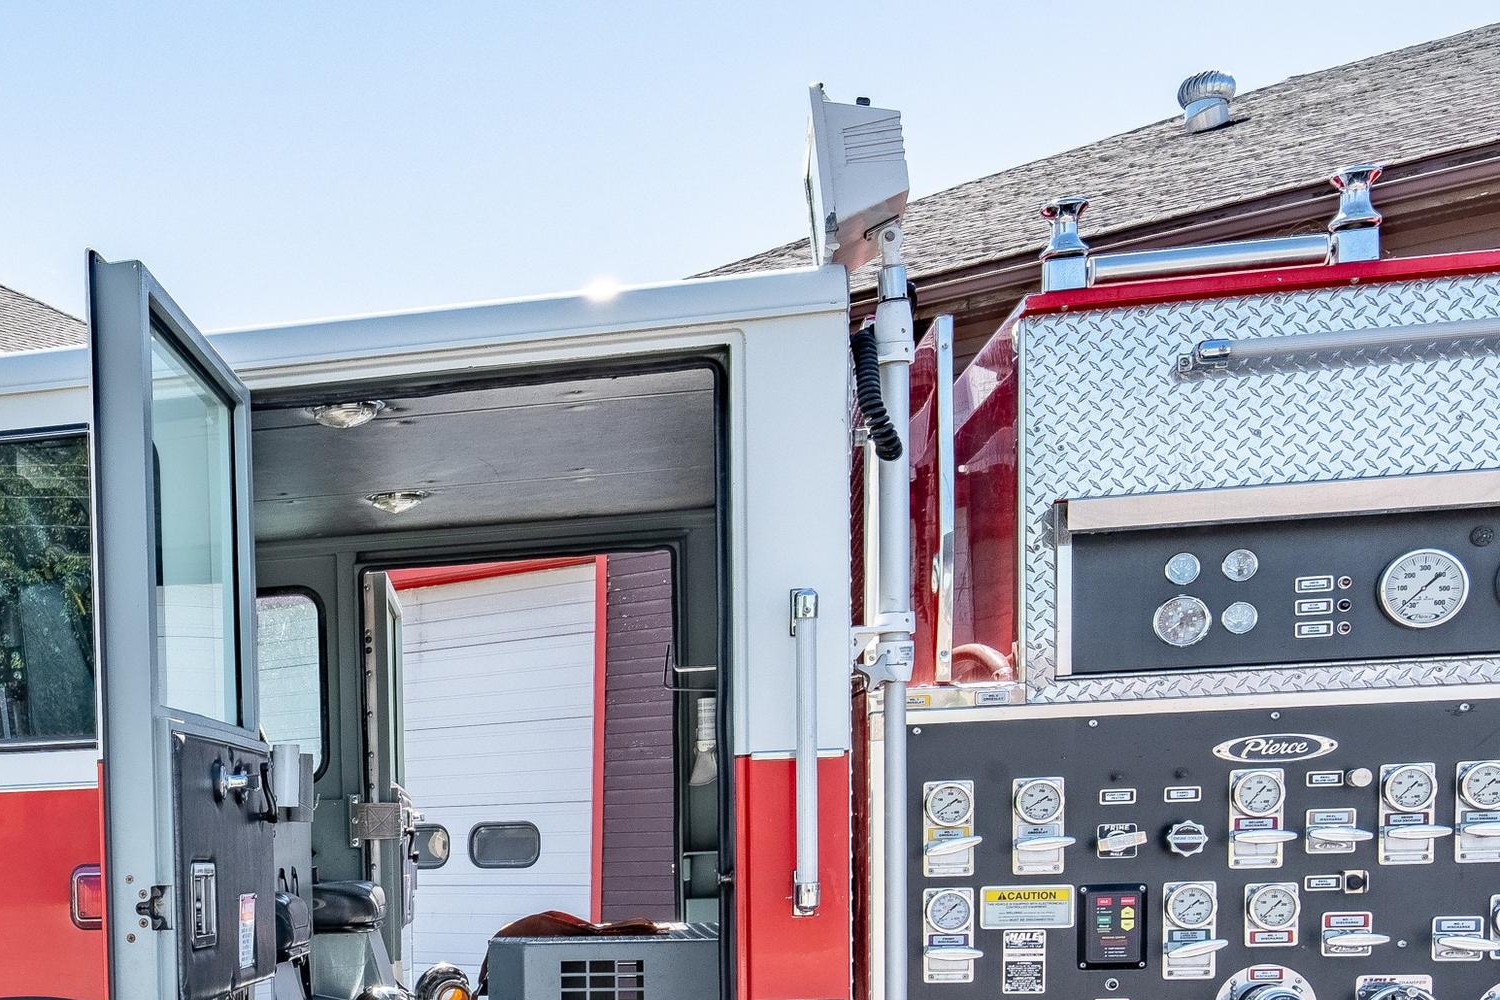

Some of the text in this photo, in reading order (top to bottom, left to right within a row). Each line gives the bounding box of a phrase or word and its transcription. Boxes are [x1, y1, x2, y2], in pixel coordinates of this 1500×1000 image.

[1240, 738, 1309, 759] Pierce
[1007, 891, 1057, 900] CAUTION
[1010, 932, 1041, 941] HALE
